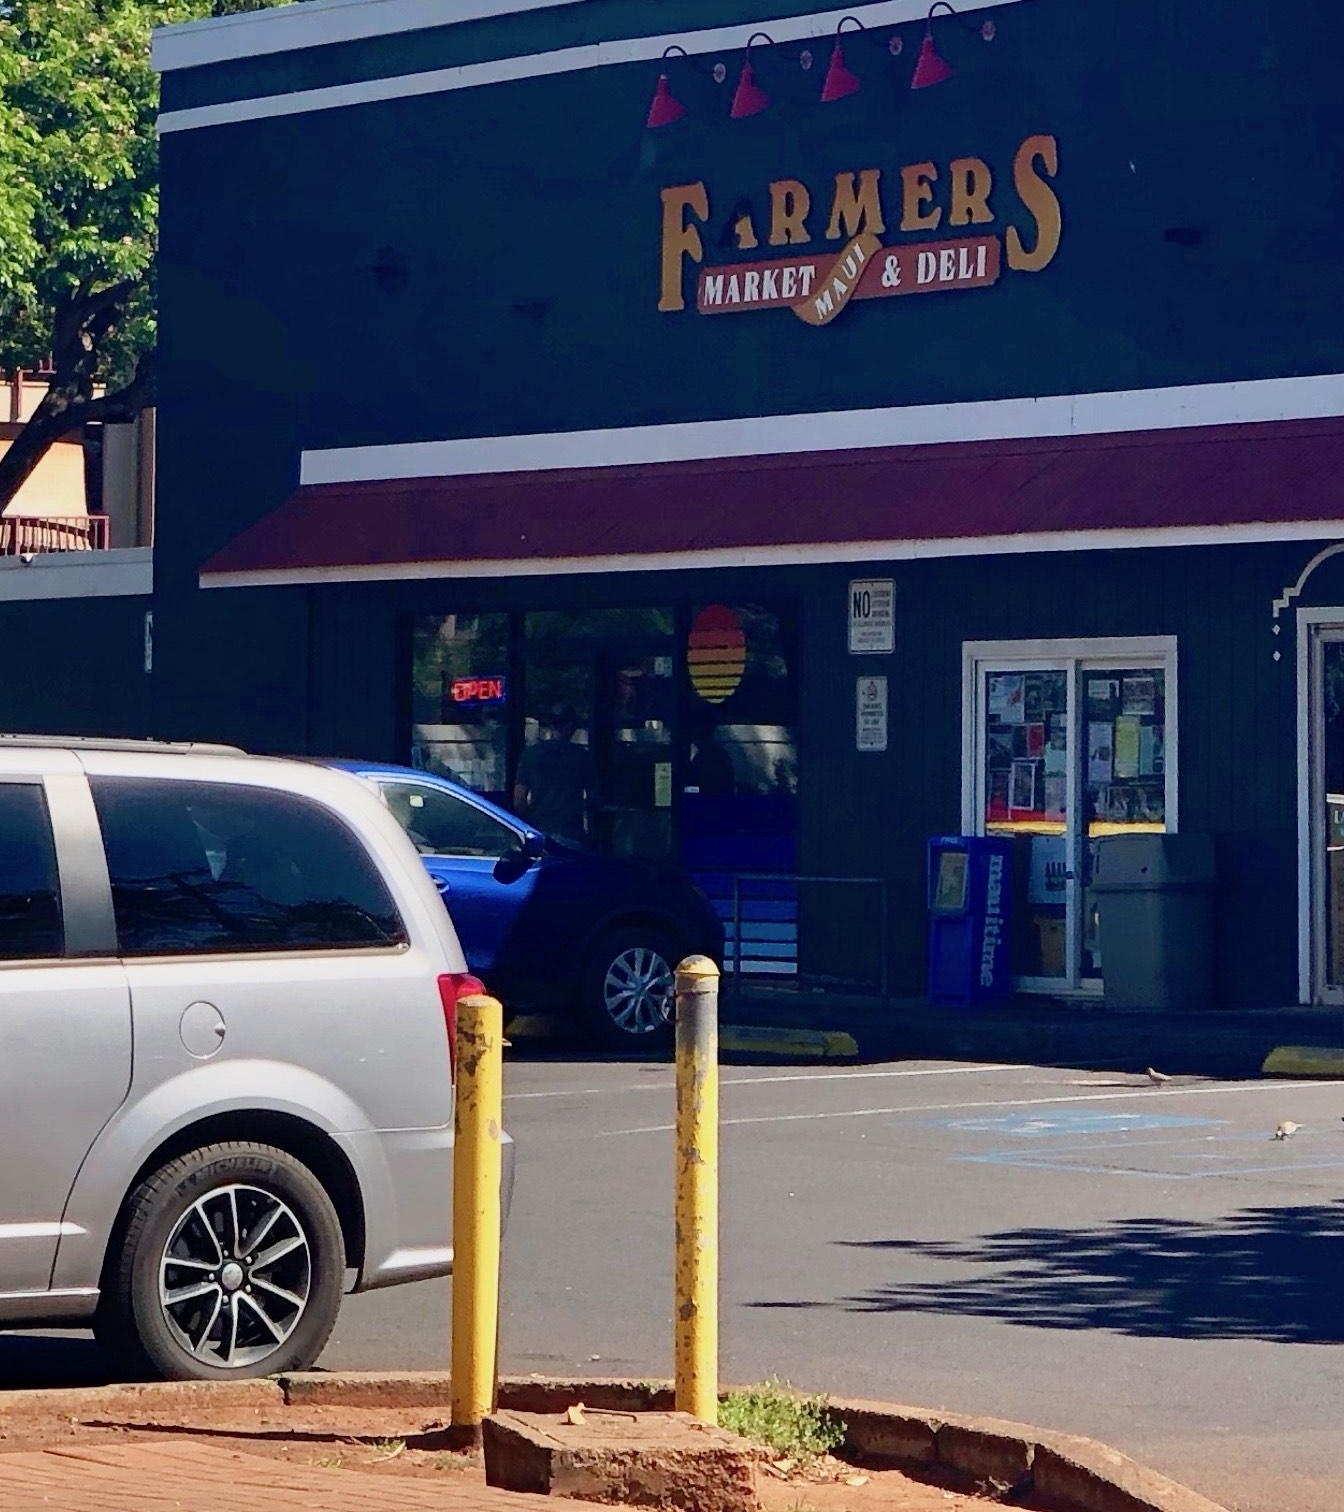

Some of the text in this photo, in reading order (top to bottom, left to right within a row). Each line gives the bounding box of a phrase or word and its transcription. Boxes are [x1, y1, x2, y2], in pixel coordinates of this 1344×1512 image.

[703, 245, 987, 306] MARKET & DELI
[814, 243, 866, 320] MAUI
[853, 590, 871, 619] NO
[452, 680, 503, 702] OPEN
